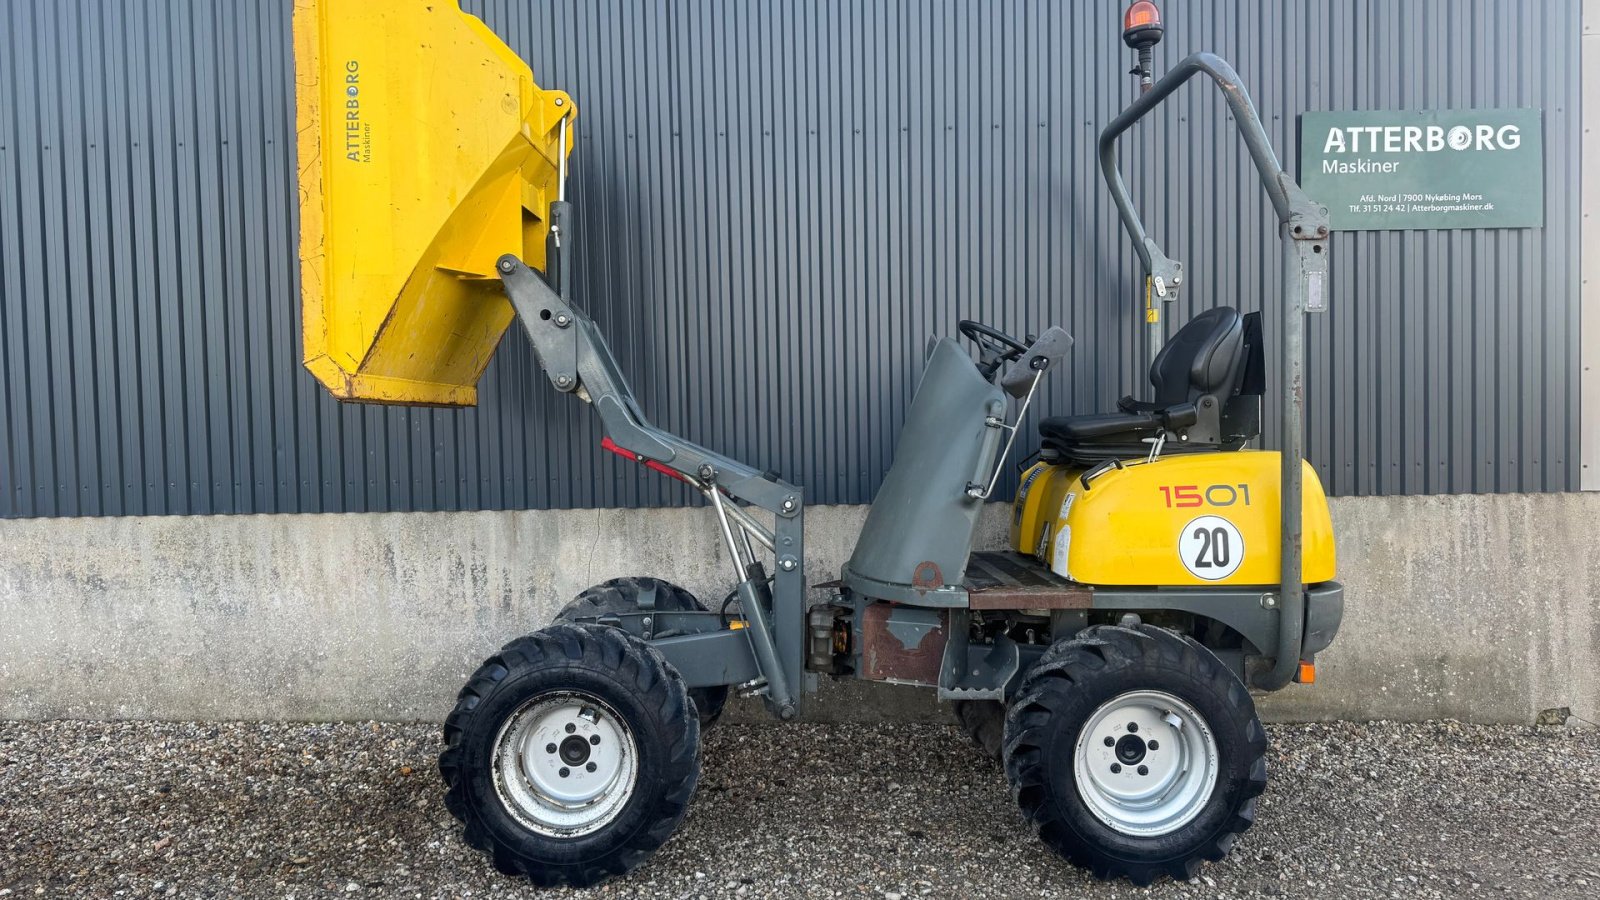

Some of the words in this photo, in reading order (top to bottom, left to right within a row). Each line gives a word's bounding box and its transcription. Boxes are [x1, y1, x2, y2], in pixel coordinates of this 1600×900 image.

[345, 60, 360, 162] ATTERBORG
[362, 122, 371, 163] Maskiner
[1323, 124, 1521, 153] ATTERBORG
[1322, 159, 1399, 174] Maskiner
[1349, 205, 1361, 213] Tlf.
[1363, 205, 1371, 213] 31
[1373, 205, 1381, 213] 51
[1384, 204, 1393, 213] 24
[1395, 204, 1406, 212] 42
[1411, 203, 1494, 213] Atterborgmaskiner.dk
[1359, 194, 1376, 203] Afd.
[1378, 194, 1397, 203] Nord
[1403, 193, 1423, 202] 7900
[1425, 193, 1460, 203] Nykøbing
[1462, 193, 1483, 201] Mors
[1159, 483, 1251, 508] 1501
[1193, 526, 1230, 568] 20
